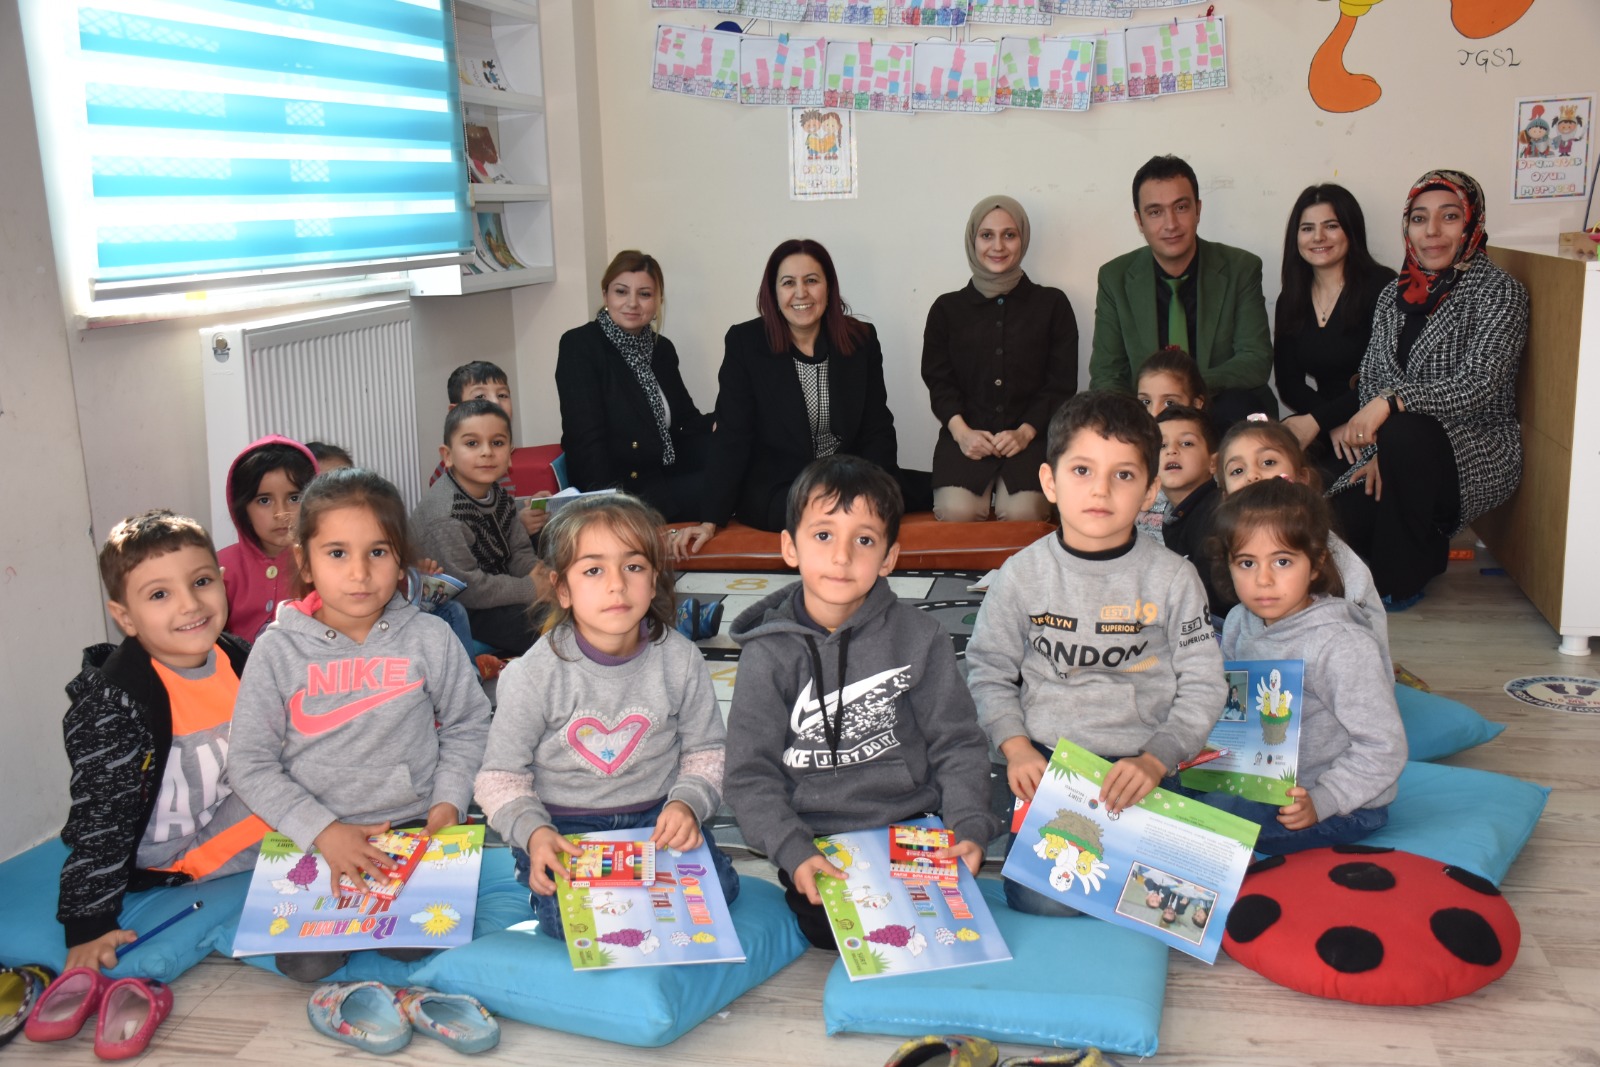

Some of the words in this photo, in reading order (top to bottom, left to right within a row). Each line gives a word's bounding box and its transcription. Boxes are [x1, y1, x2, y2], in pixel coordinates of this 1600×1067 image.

[1531, 171, 1565, 182] Oyun
[1100, 624, 1135, 633] SUPERIOR
[1179, 633, 1210, 648] SUPERIOR
[307, 656, 410, 697] NIKE
[583, 732, 628, 747] LOVE
[862, 742, 882, 757] DO
[676, 863, 715, 925] BOYAMA
[298, 914, 400, 941] BOYAMA
